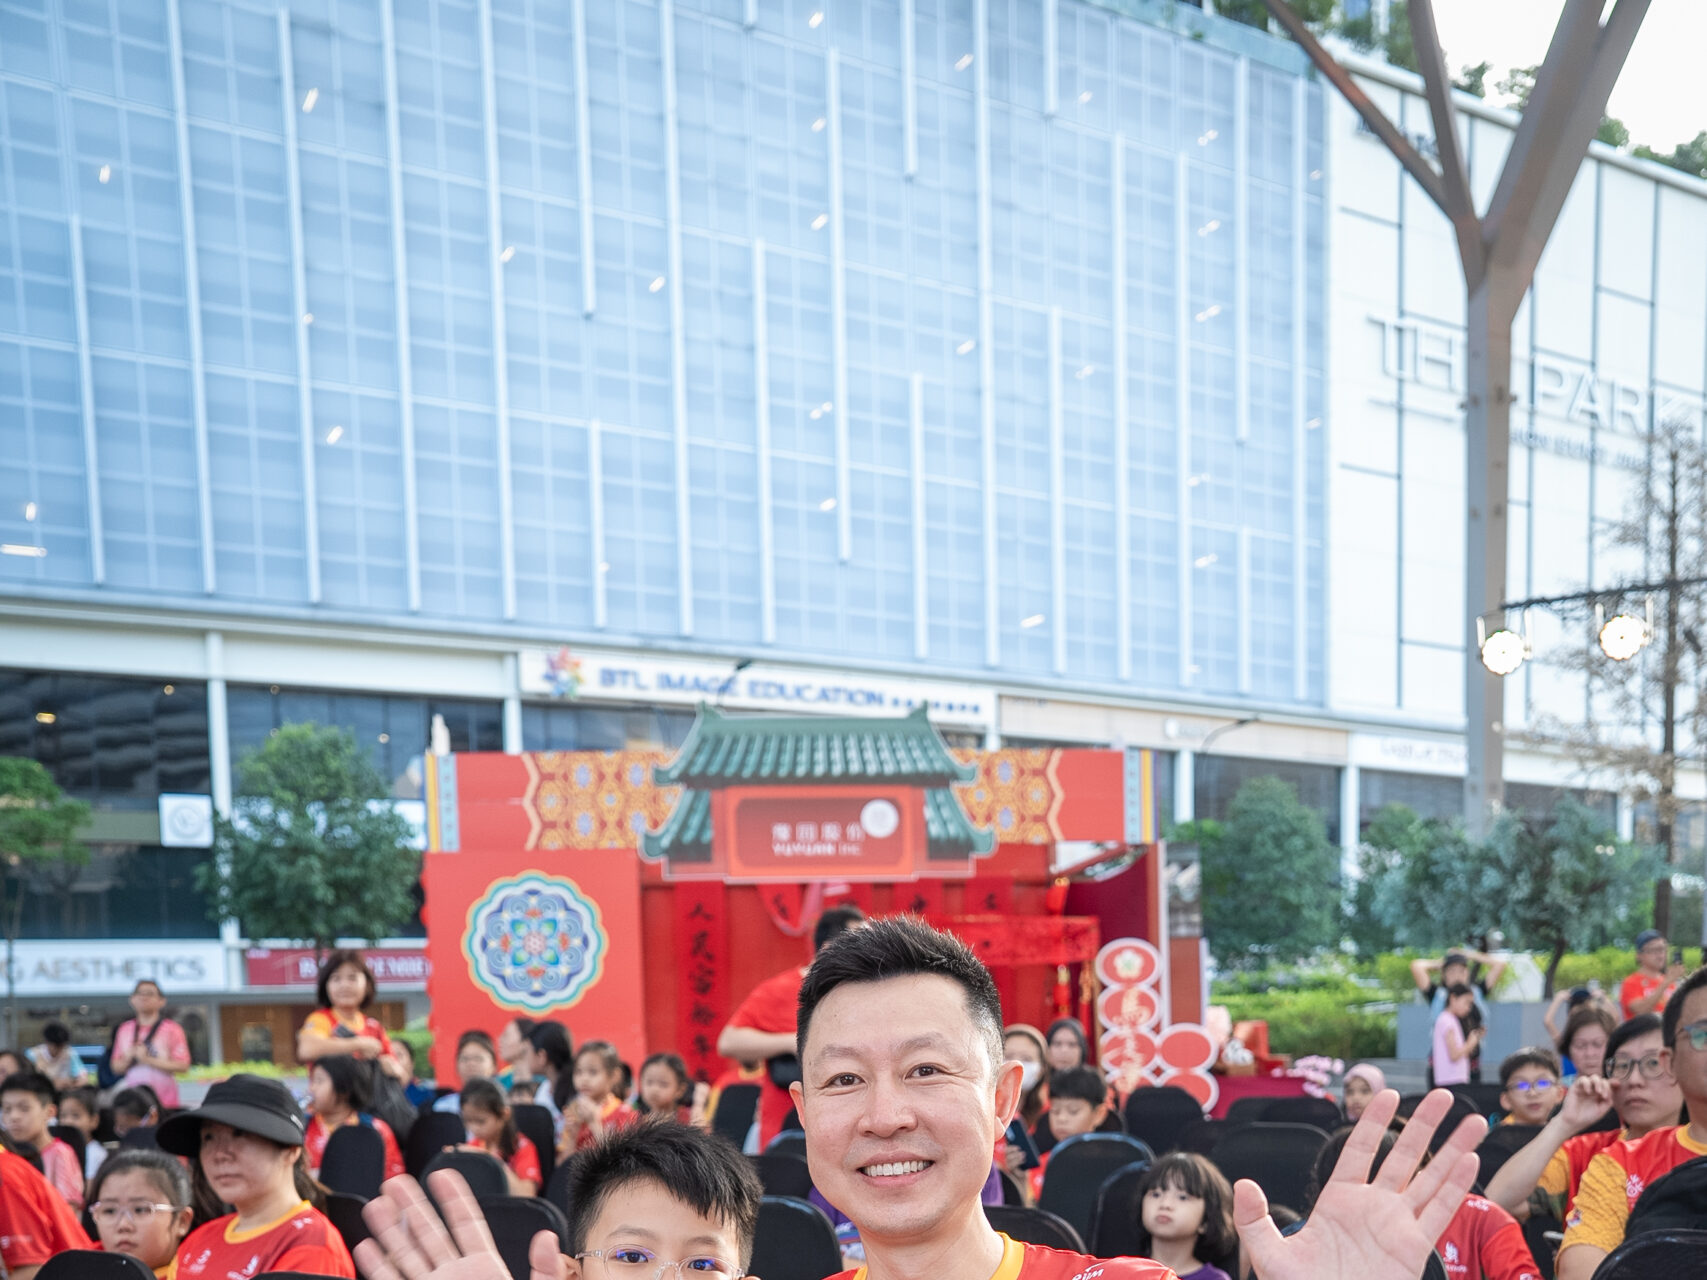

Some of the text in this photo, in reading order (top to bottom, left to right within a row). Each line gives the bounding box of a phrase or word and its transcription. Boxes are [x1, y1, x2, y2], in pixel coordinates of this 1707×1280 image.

[600, 667, 648, 690] BTL
[748, 680, 885, 706] EDUCATION
[33, 956, 206, 981] AESTHETICS
